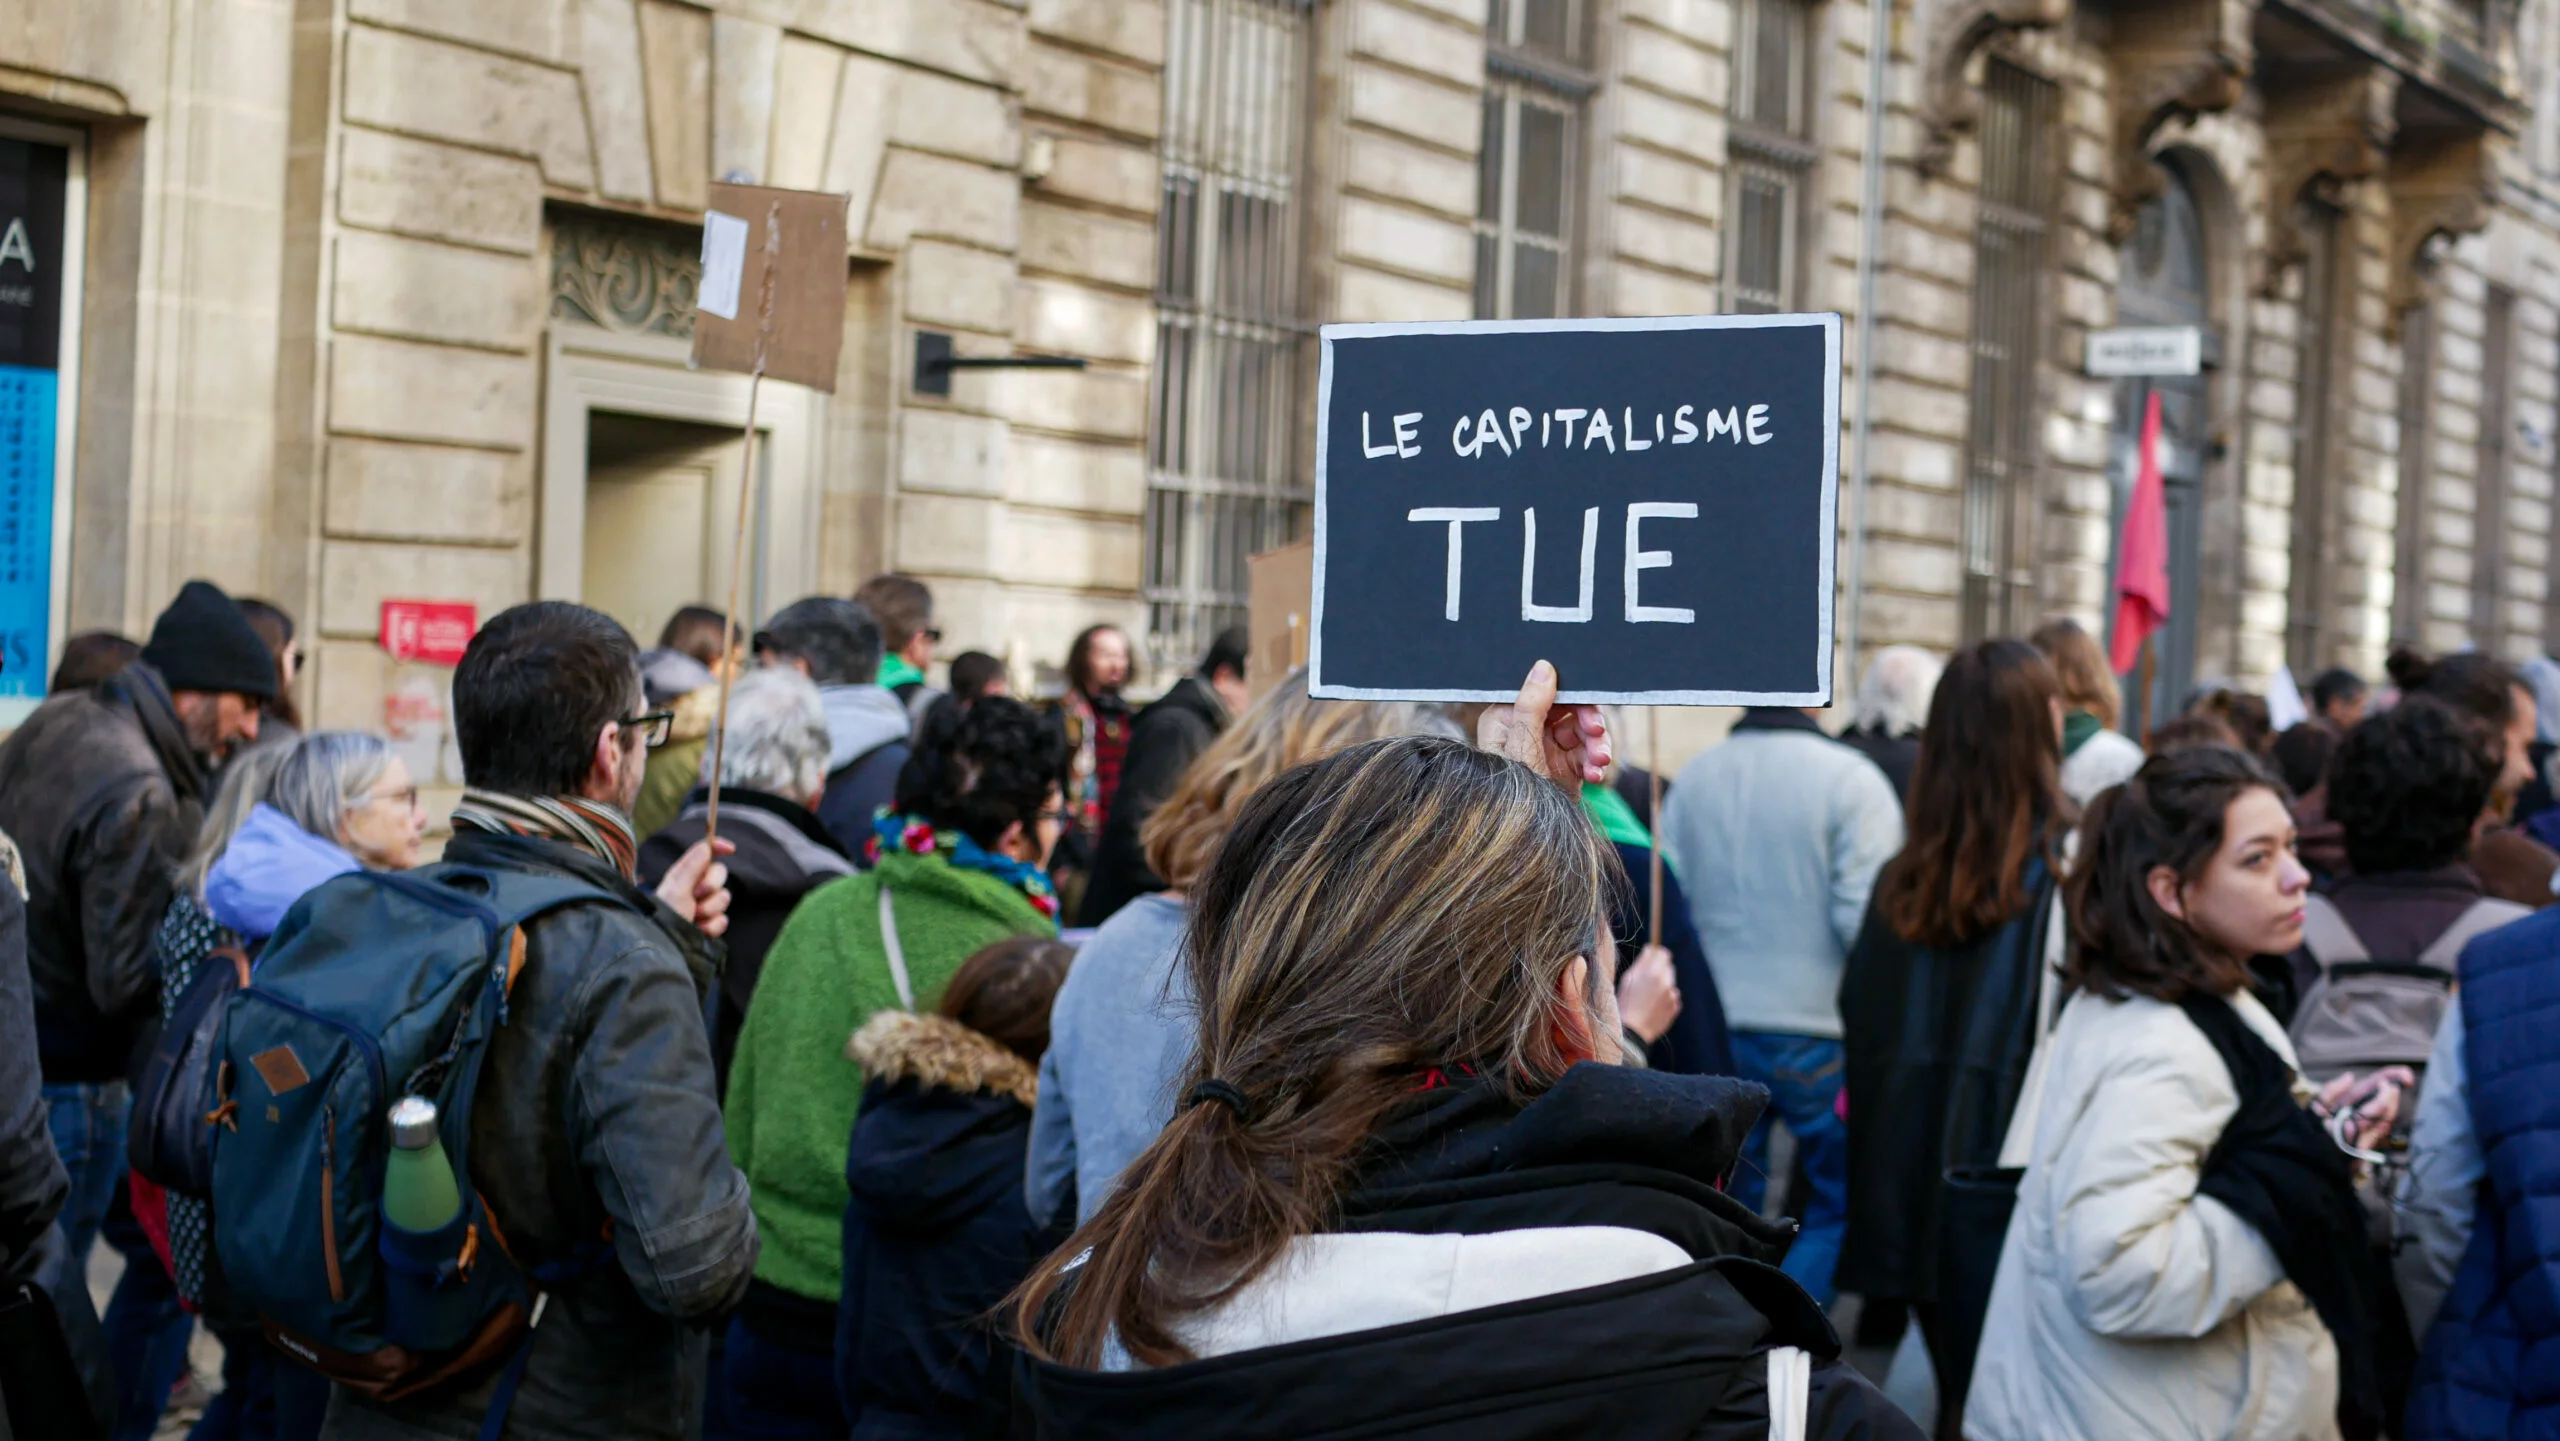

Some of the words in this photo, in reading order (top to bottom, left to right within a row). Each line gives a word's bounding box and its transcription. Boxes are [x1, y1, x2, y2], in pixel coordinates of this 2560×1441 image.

[1361, 410, 1425, 460] LE
[1452, 402, 1775, 460] CAPITALISME
[1406, 501, 1700, 625] TUE
